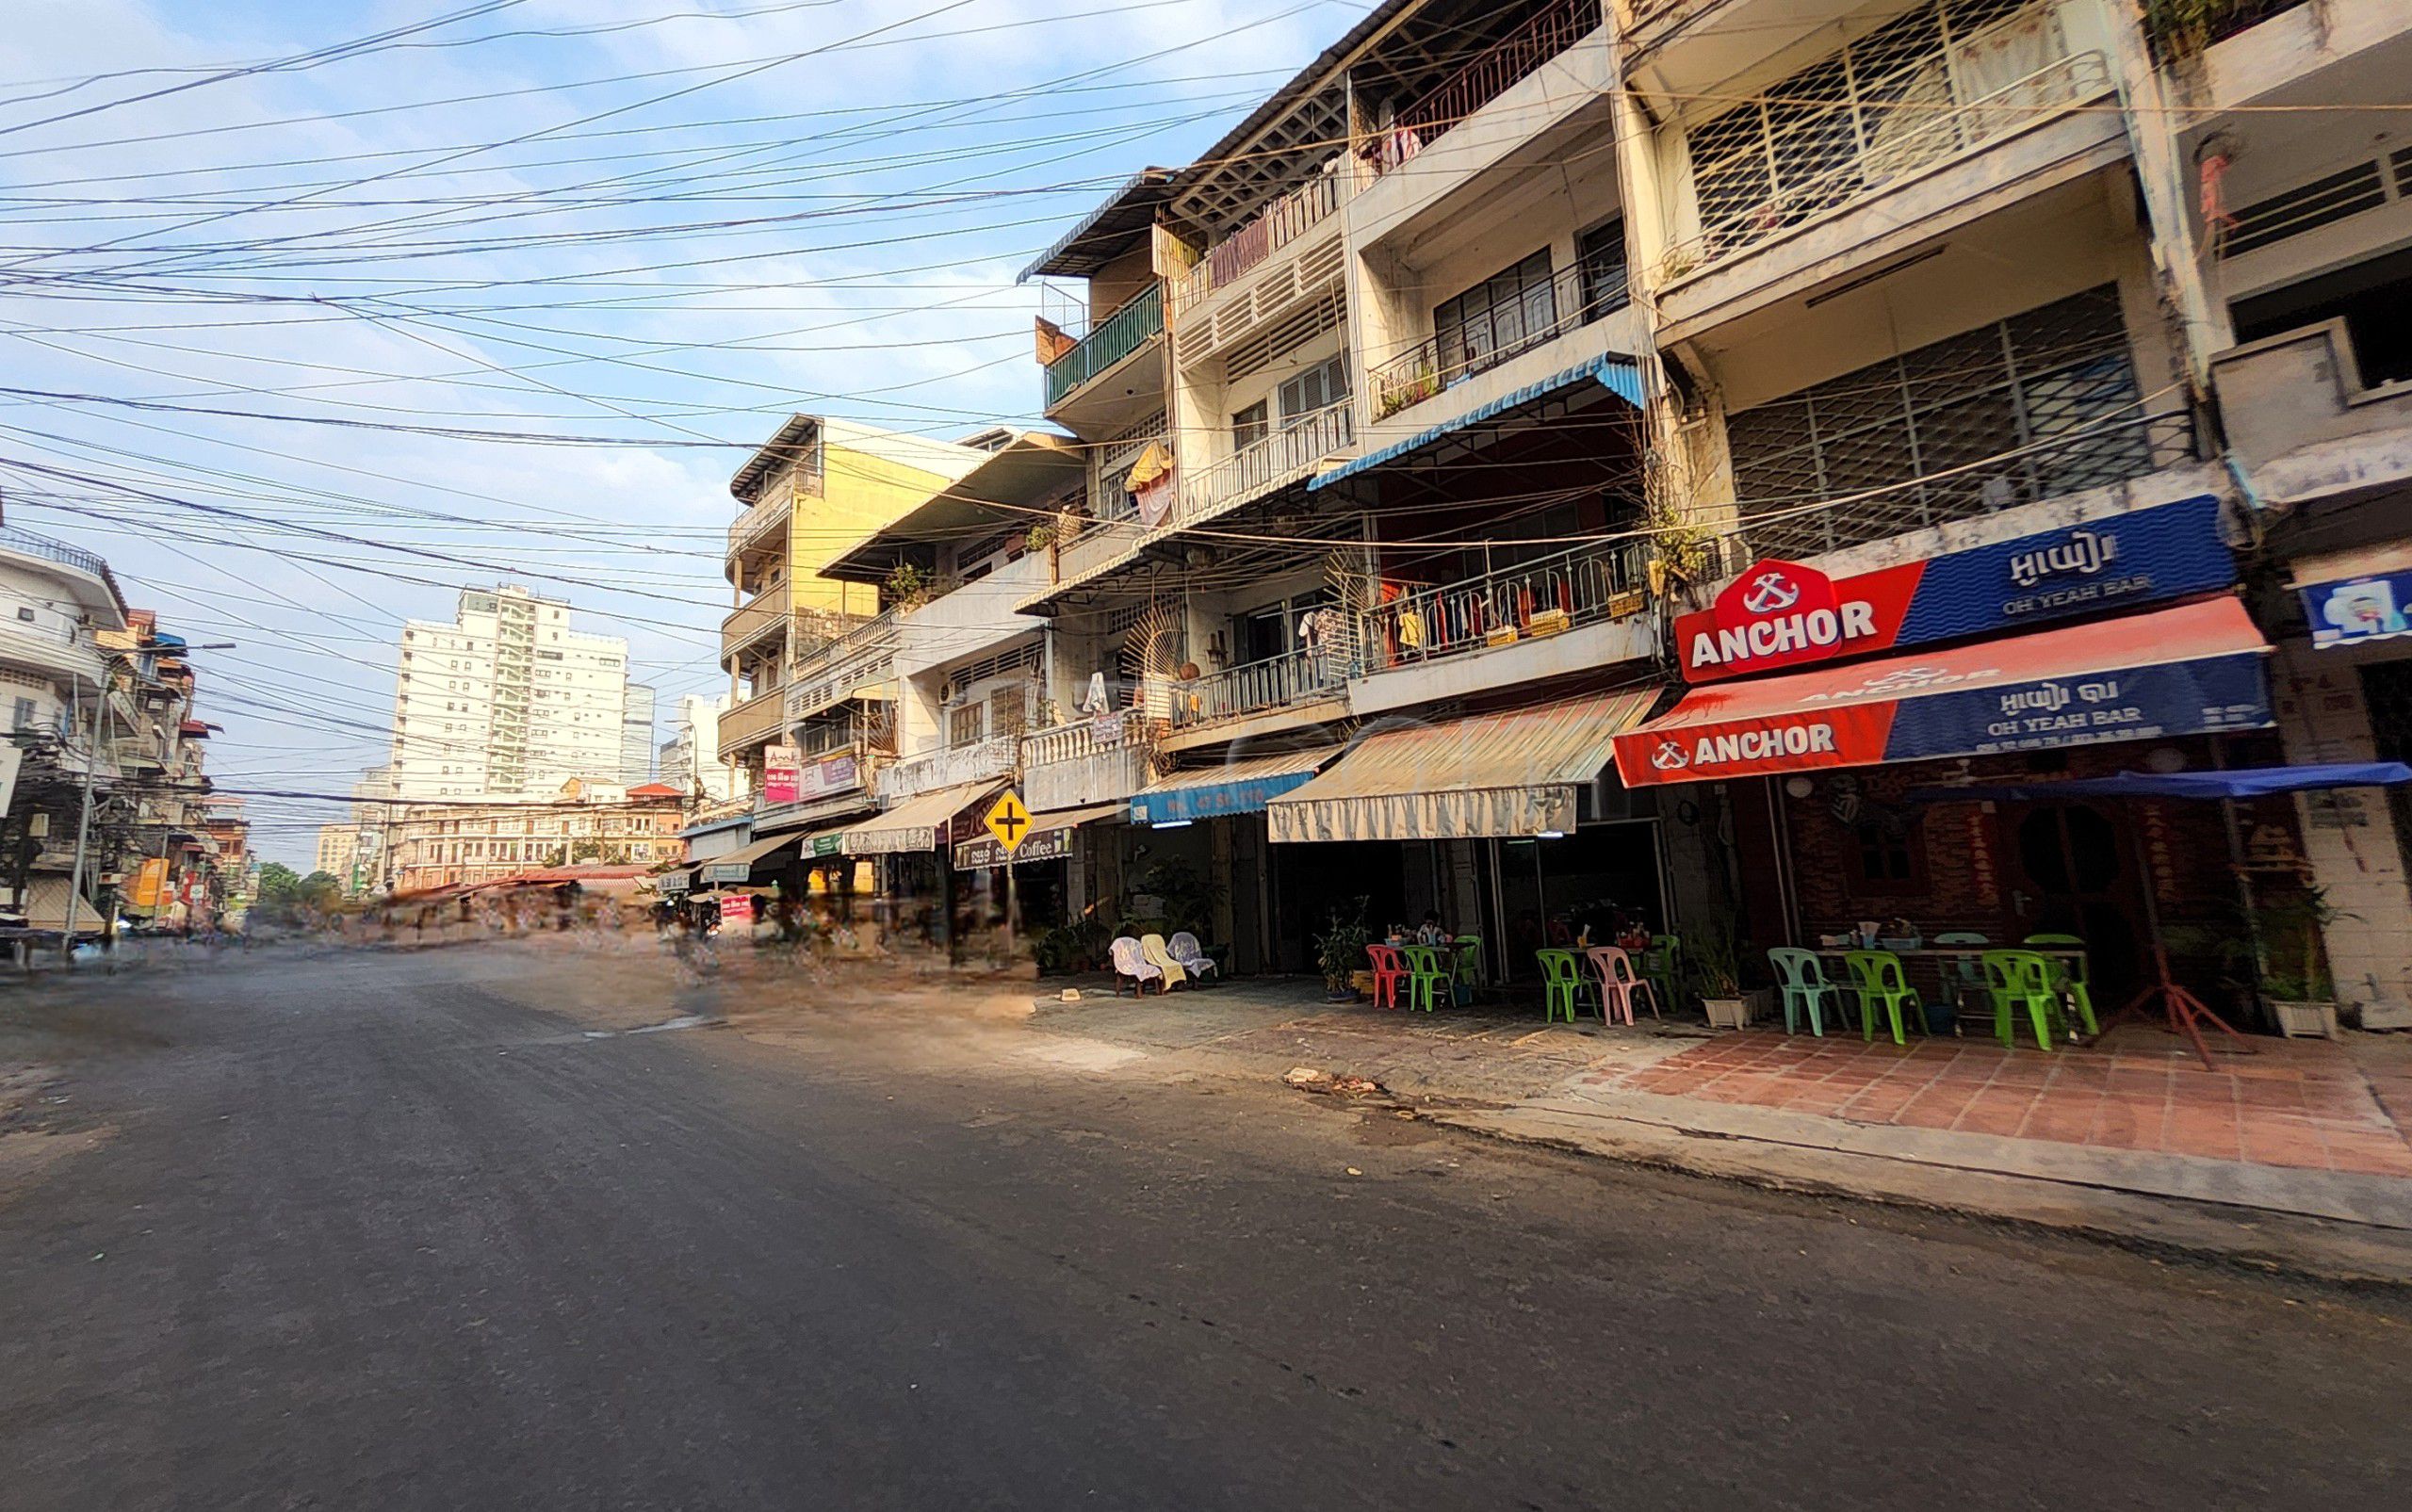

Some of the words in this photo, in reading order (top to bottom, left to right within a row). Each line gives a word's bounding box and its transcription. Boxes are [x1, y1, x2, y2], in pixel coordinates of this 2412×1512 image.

[2003, 595, 2034, 615] OH
[2039, 583, 2096, 610] YEAH
[2103, 574, 2153, 597] BAR
[1690, 600, 1878, 668] ANCHOR
[1987, 719, 2018, 737] OH
[2023, 712, 2089, 733] YEAH
[2093, 707, 2143, 725] BAR
[1694, 723, 1835, 765] ANCHOR
[1019, 840, 1052, 858] Coffee
